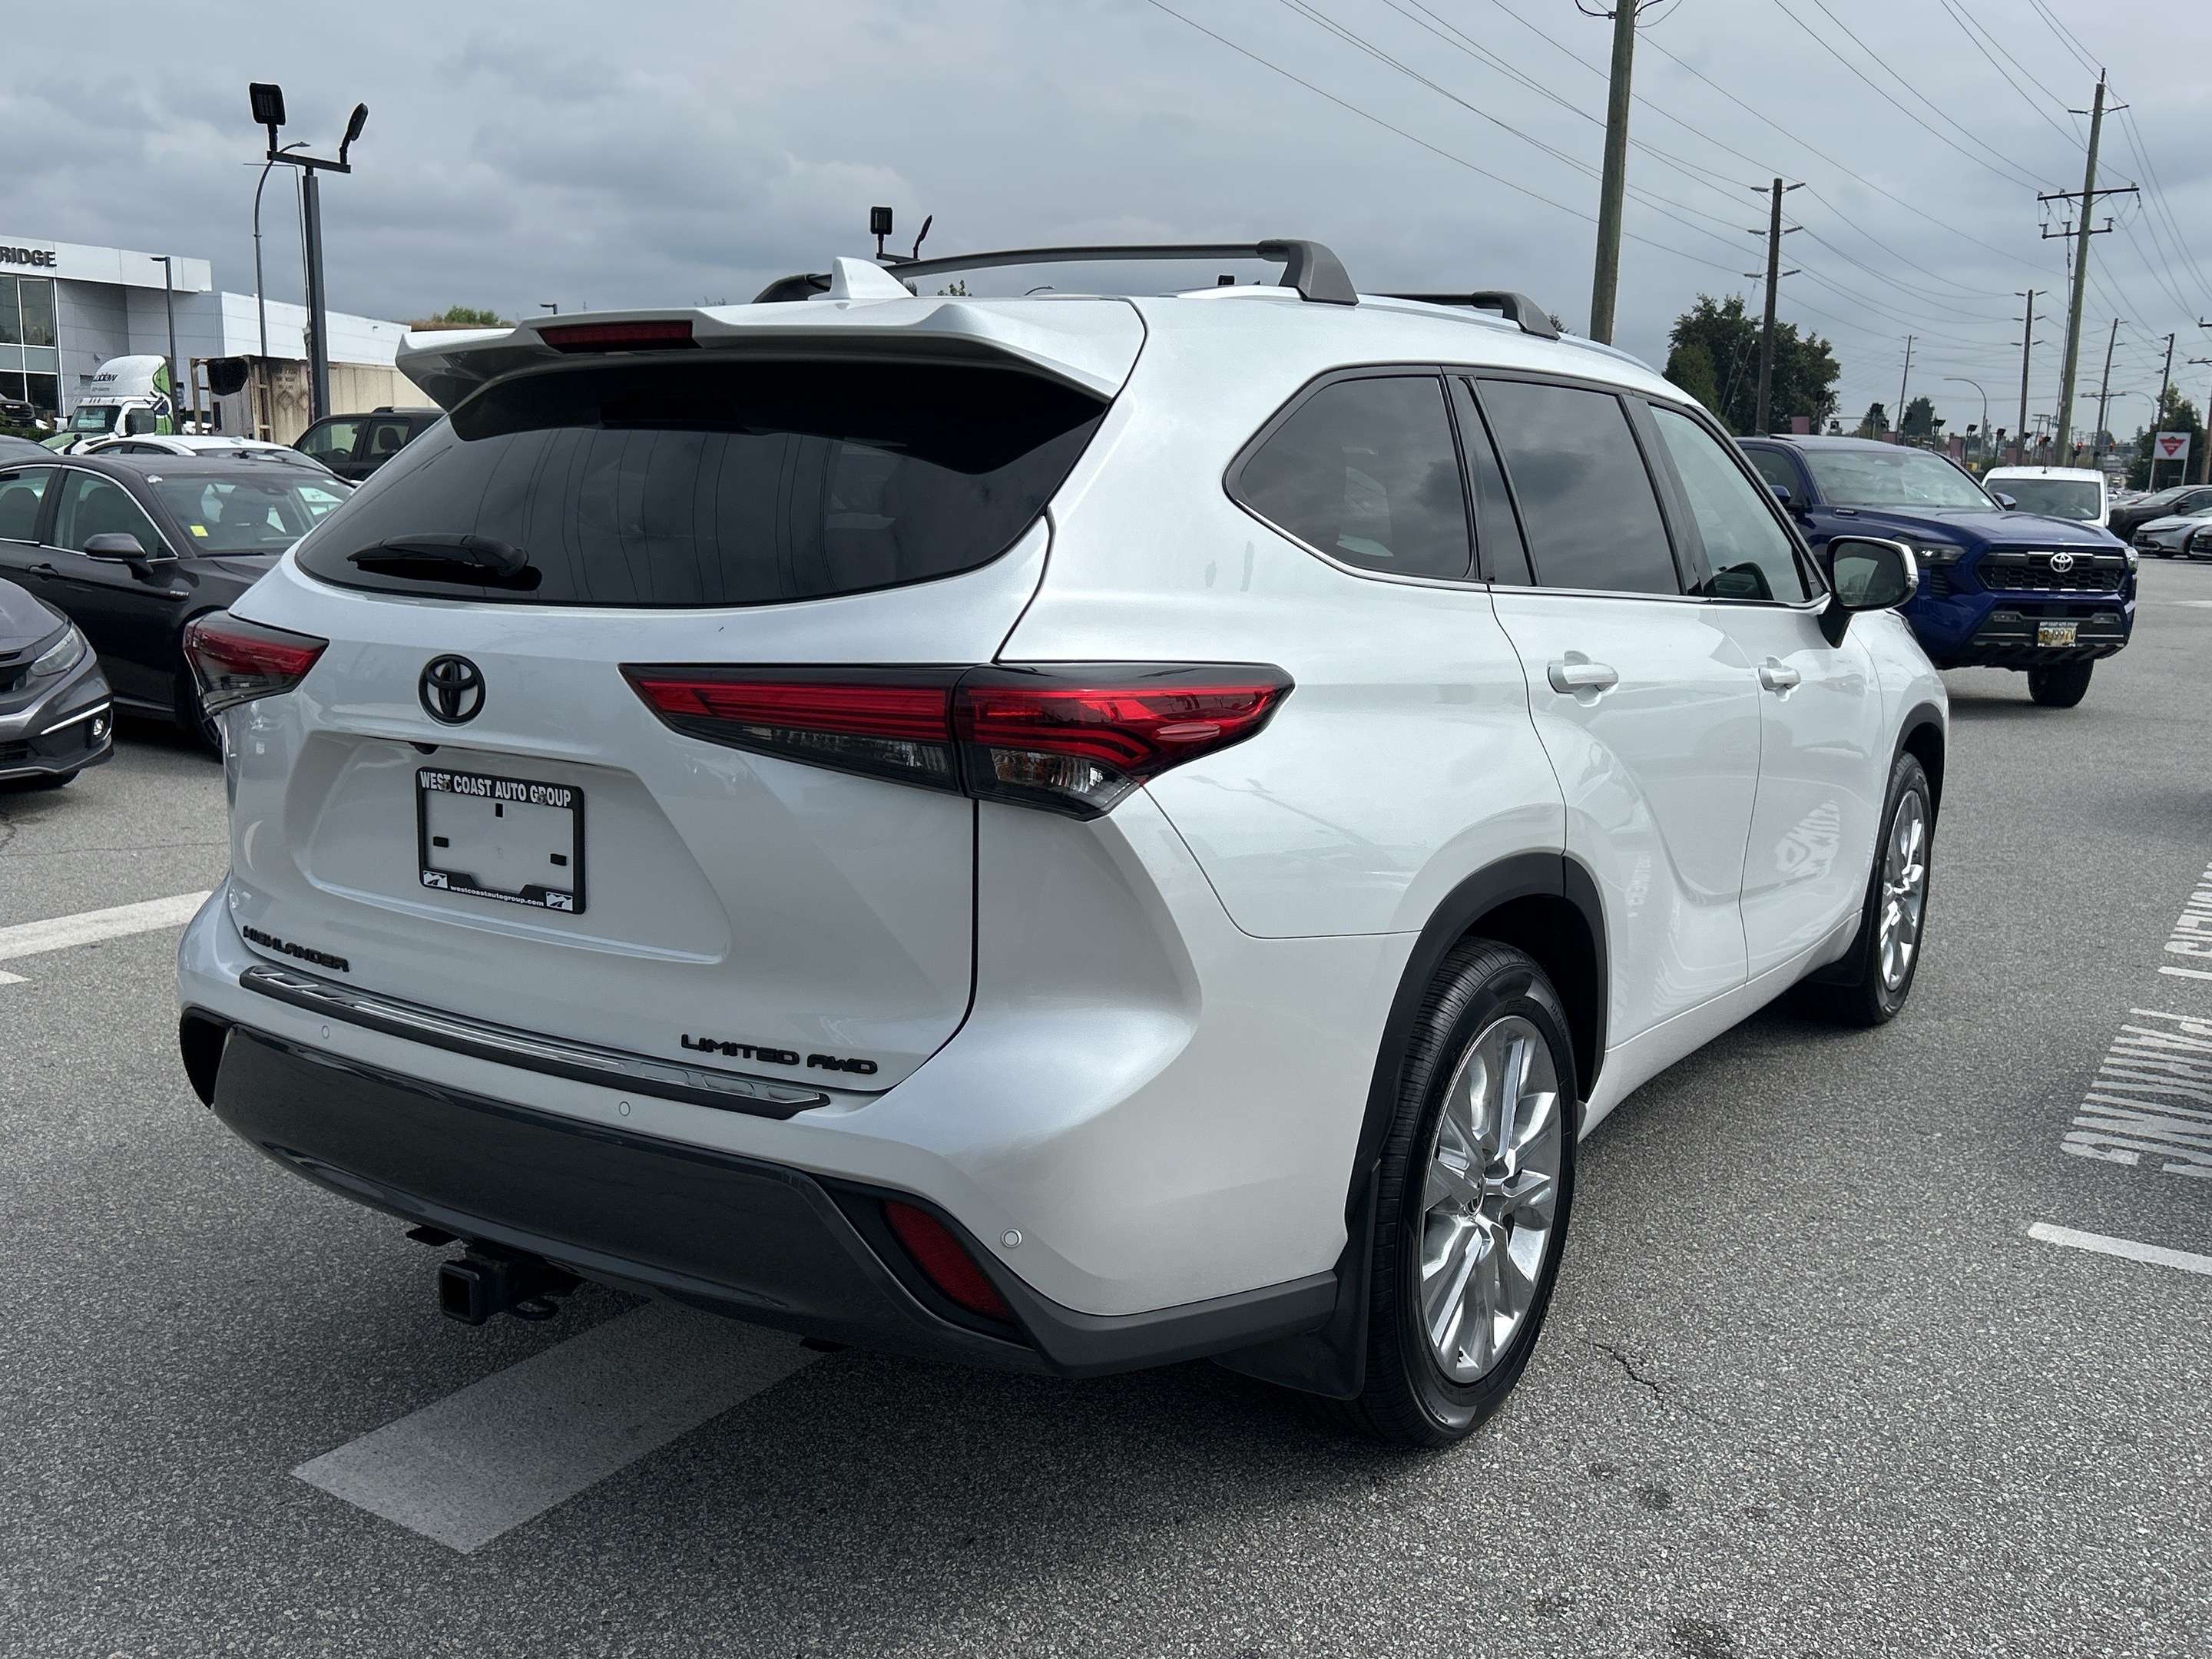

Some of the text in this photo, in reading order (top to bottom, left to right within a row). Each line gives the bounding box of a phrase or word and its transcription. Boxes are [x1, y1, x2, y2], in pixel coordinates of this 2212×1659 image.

[453, 775, 492, 796] COAST
[495, 780, 527, 801] AUTO
[450, 885, 544, 907] westcoastautogroup.com
[680, 1034, 878, 1075] LIMITED AWD
